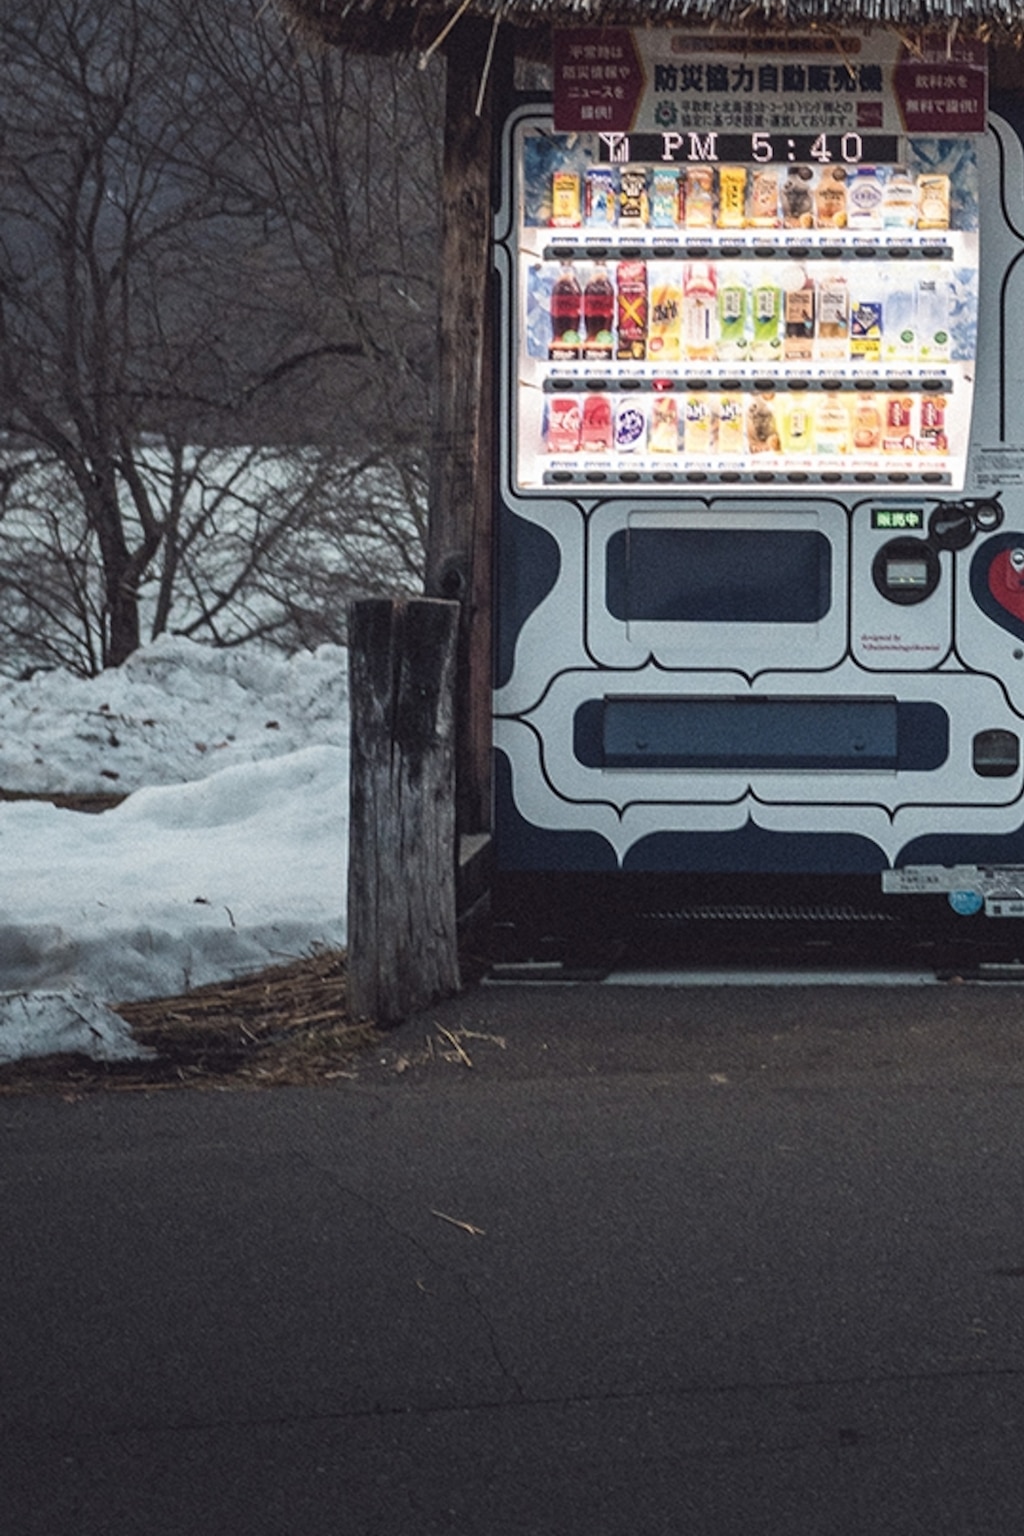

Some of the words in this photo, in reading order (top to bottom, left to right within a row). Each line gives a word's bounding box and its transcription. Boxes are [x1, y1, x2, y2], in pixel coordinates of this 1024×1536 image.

[567, 85, 625, 100] ニュースを
[654, 64, 883, 93] 防災協力自動販売機
[661, 133, 720, 161] PM
[751, 133, 864, 162] 5:40
